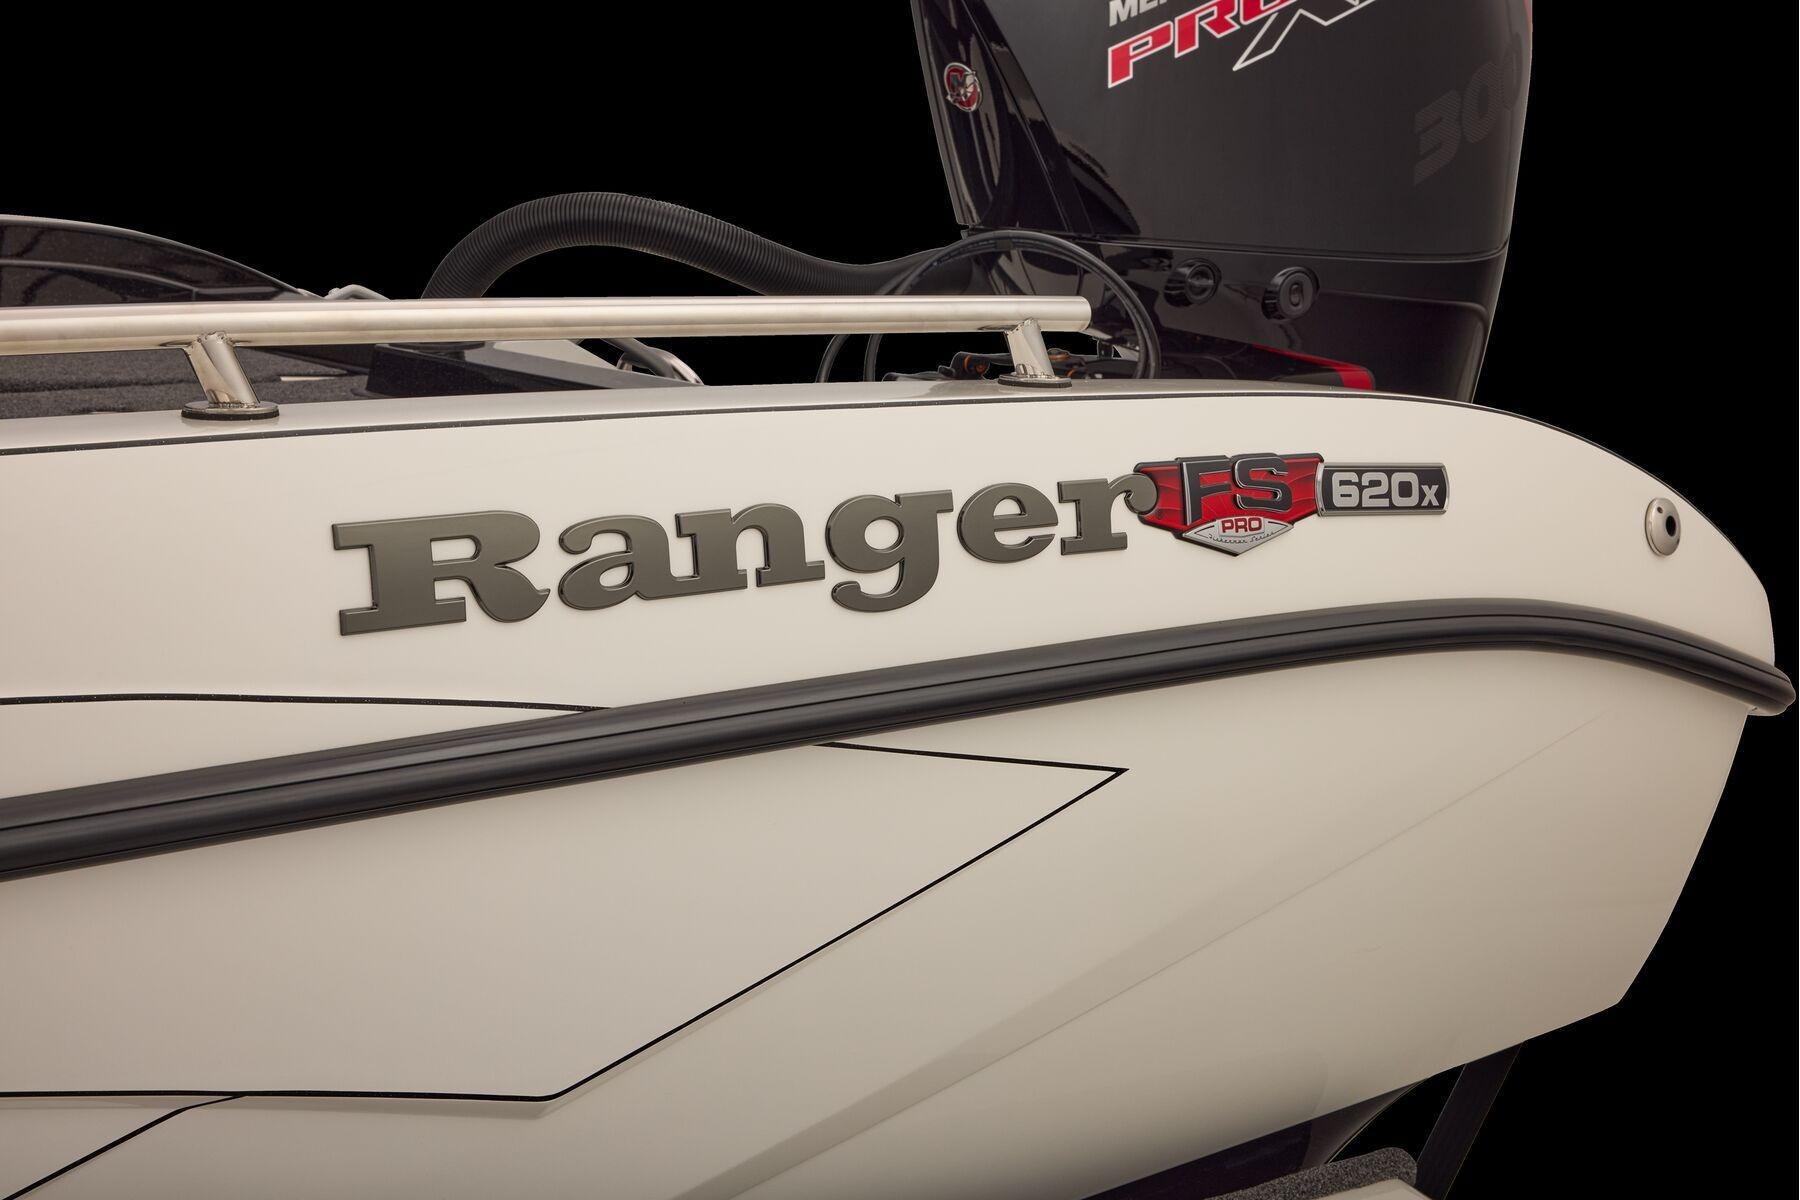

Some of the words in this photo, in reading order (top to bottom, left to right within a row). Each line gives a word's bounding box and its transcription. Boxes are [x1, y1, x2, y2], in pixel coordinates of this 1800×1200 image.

[1181, 455, 1294, 526] FS
[1221, 517, 1262, 533] PRO
[331, 472, 1158, 636] Ranger
